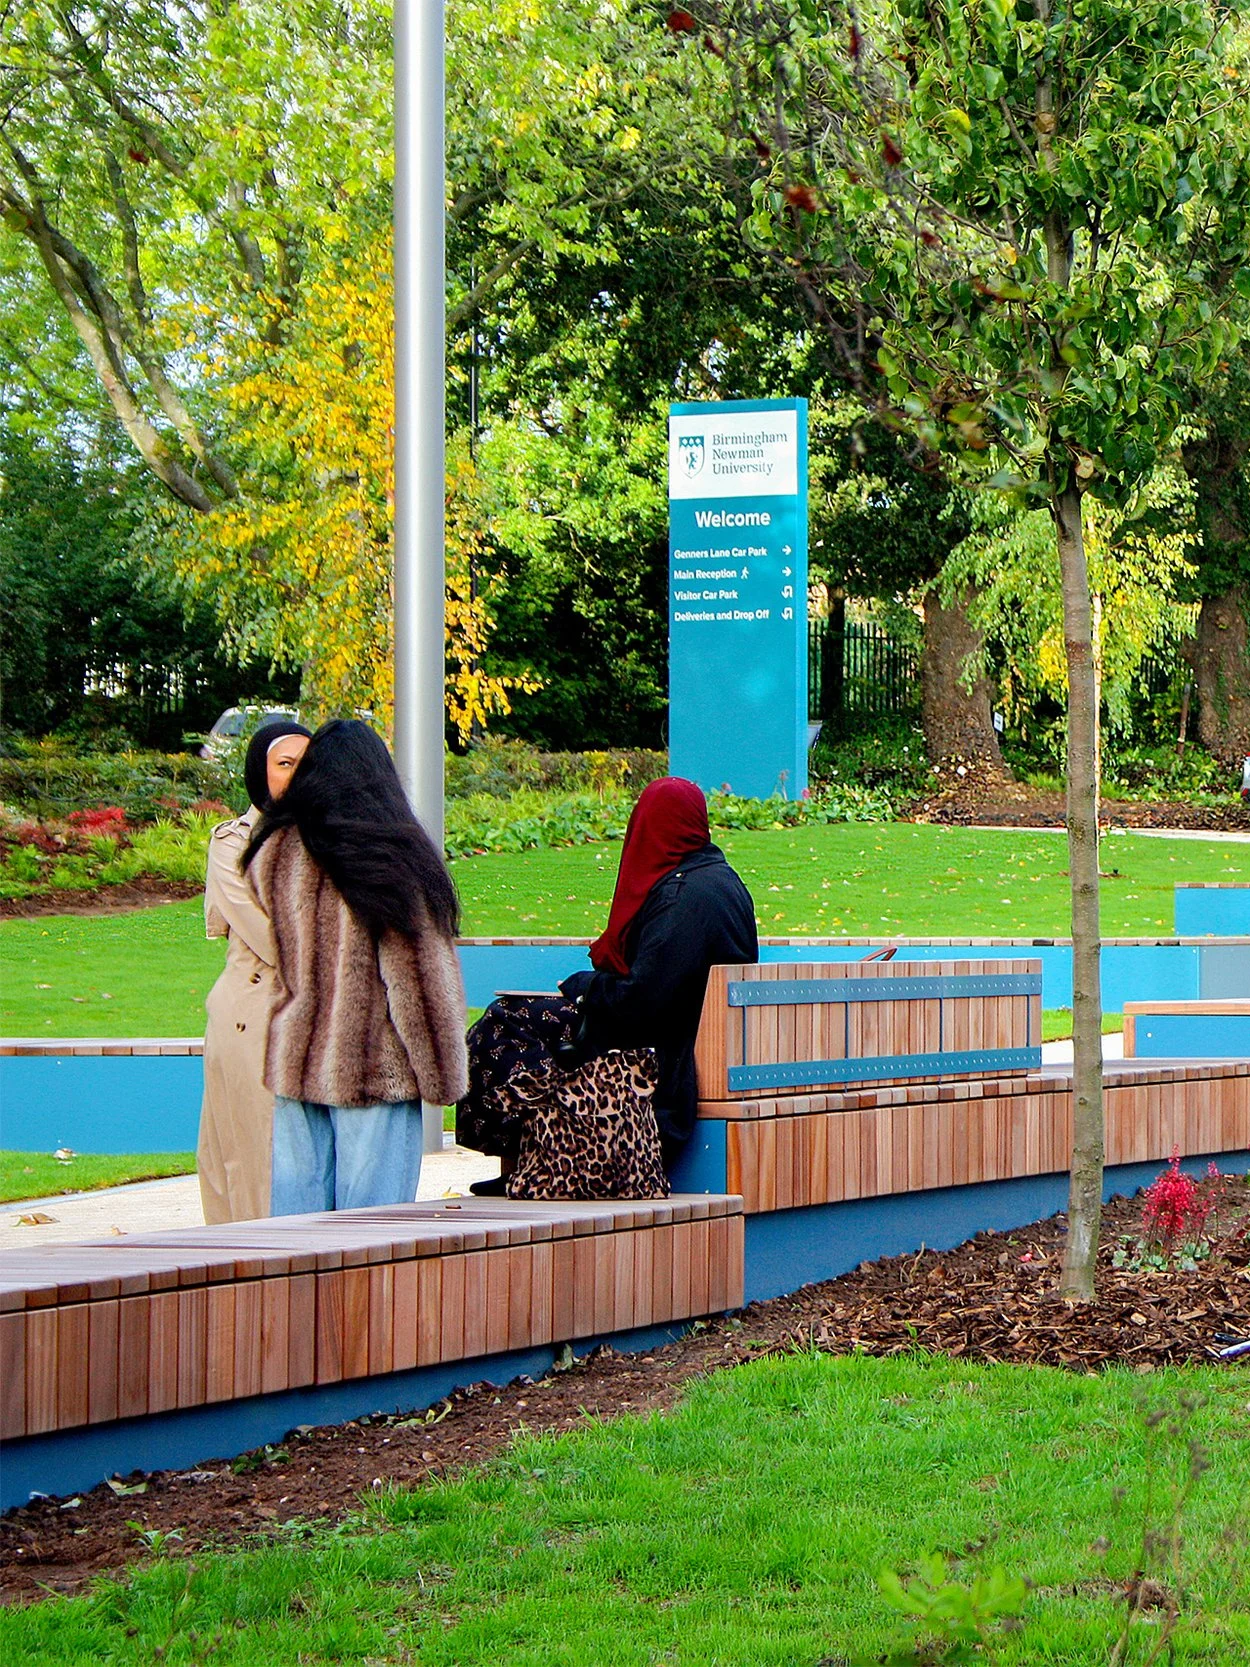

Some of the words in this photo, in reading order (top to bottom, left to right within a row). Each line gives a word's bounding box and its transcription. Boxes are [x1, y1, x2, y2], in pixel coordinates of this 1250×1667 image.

[712, 431, 788, 447] Birmingham
[712, 448, 764, 460] Newman
[712, 461, 774, 476] University
[695, 510, 771, 528] Welcome
[674, 549, 709, 559] Genners
[710, 548, 731, 558] Lane
[731, 547, 747, 557] Car
[748, 546, 768, 556] Park
[674, 570, 695, 579] Main
[696, 568, 737, 580] Reception
[674, 591, 702, 601] Visitor
[702, 590, 718, 600] Car
[719, 589, 739, 599] Park
[674, 611, 715, 622] Deliveries
[716, 610, 733, 620] and
[733, 609, 755, 621] Drop
[755, 608, 770, 619] Off
